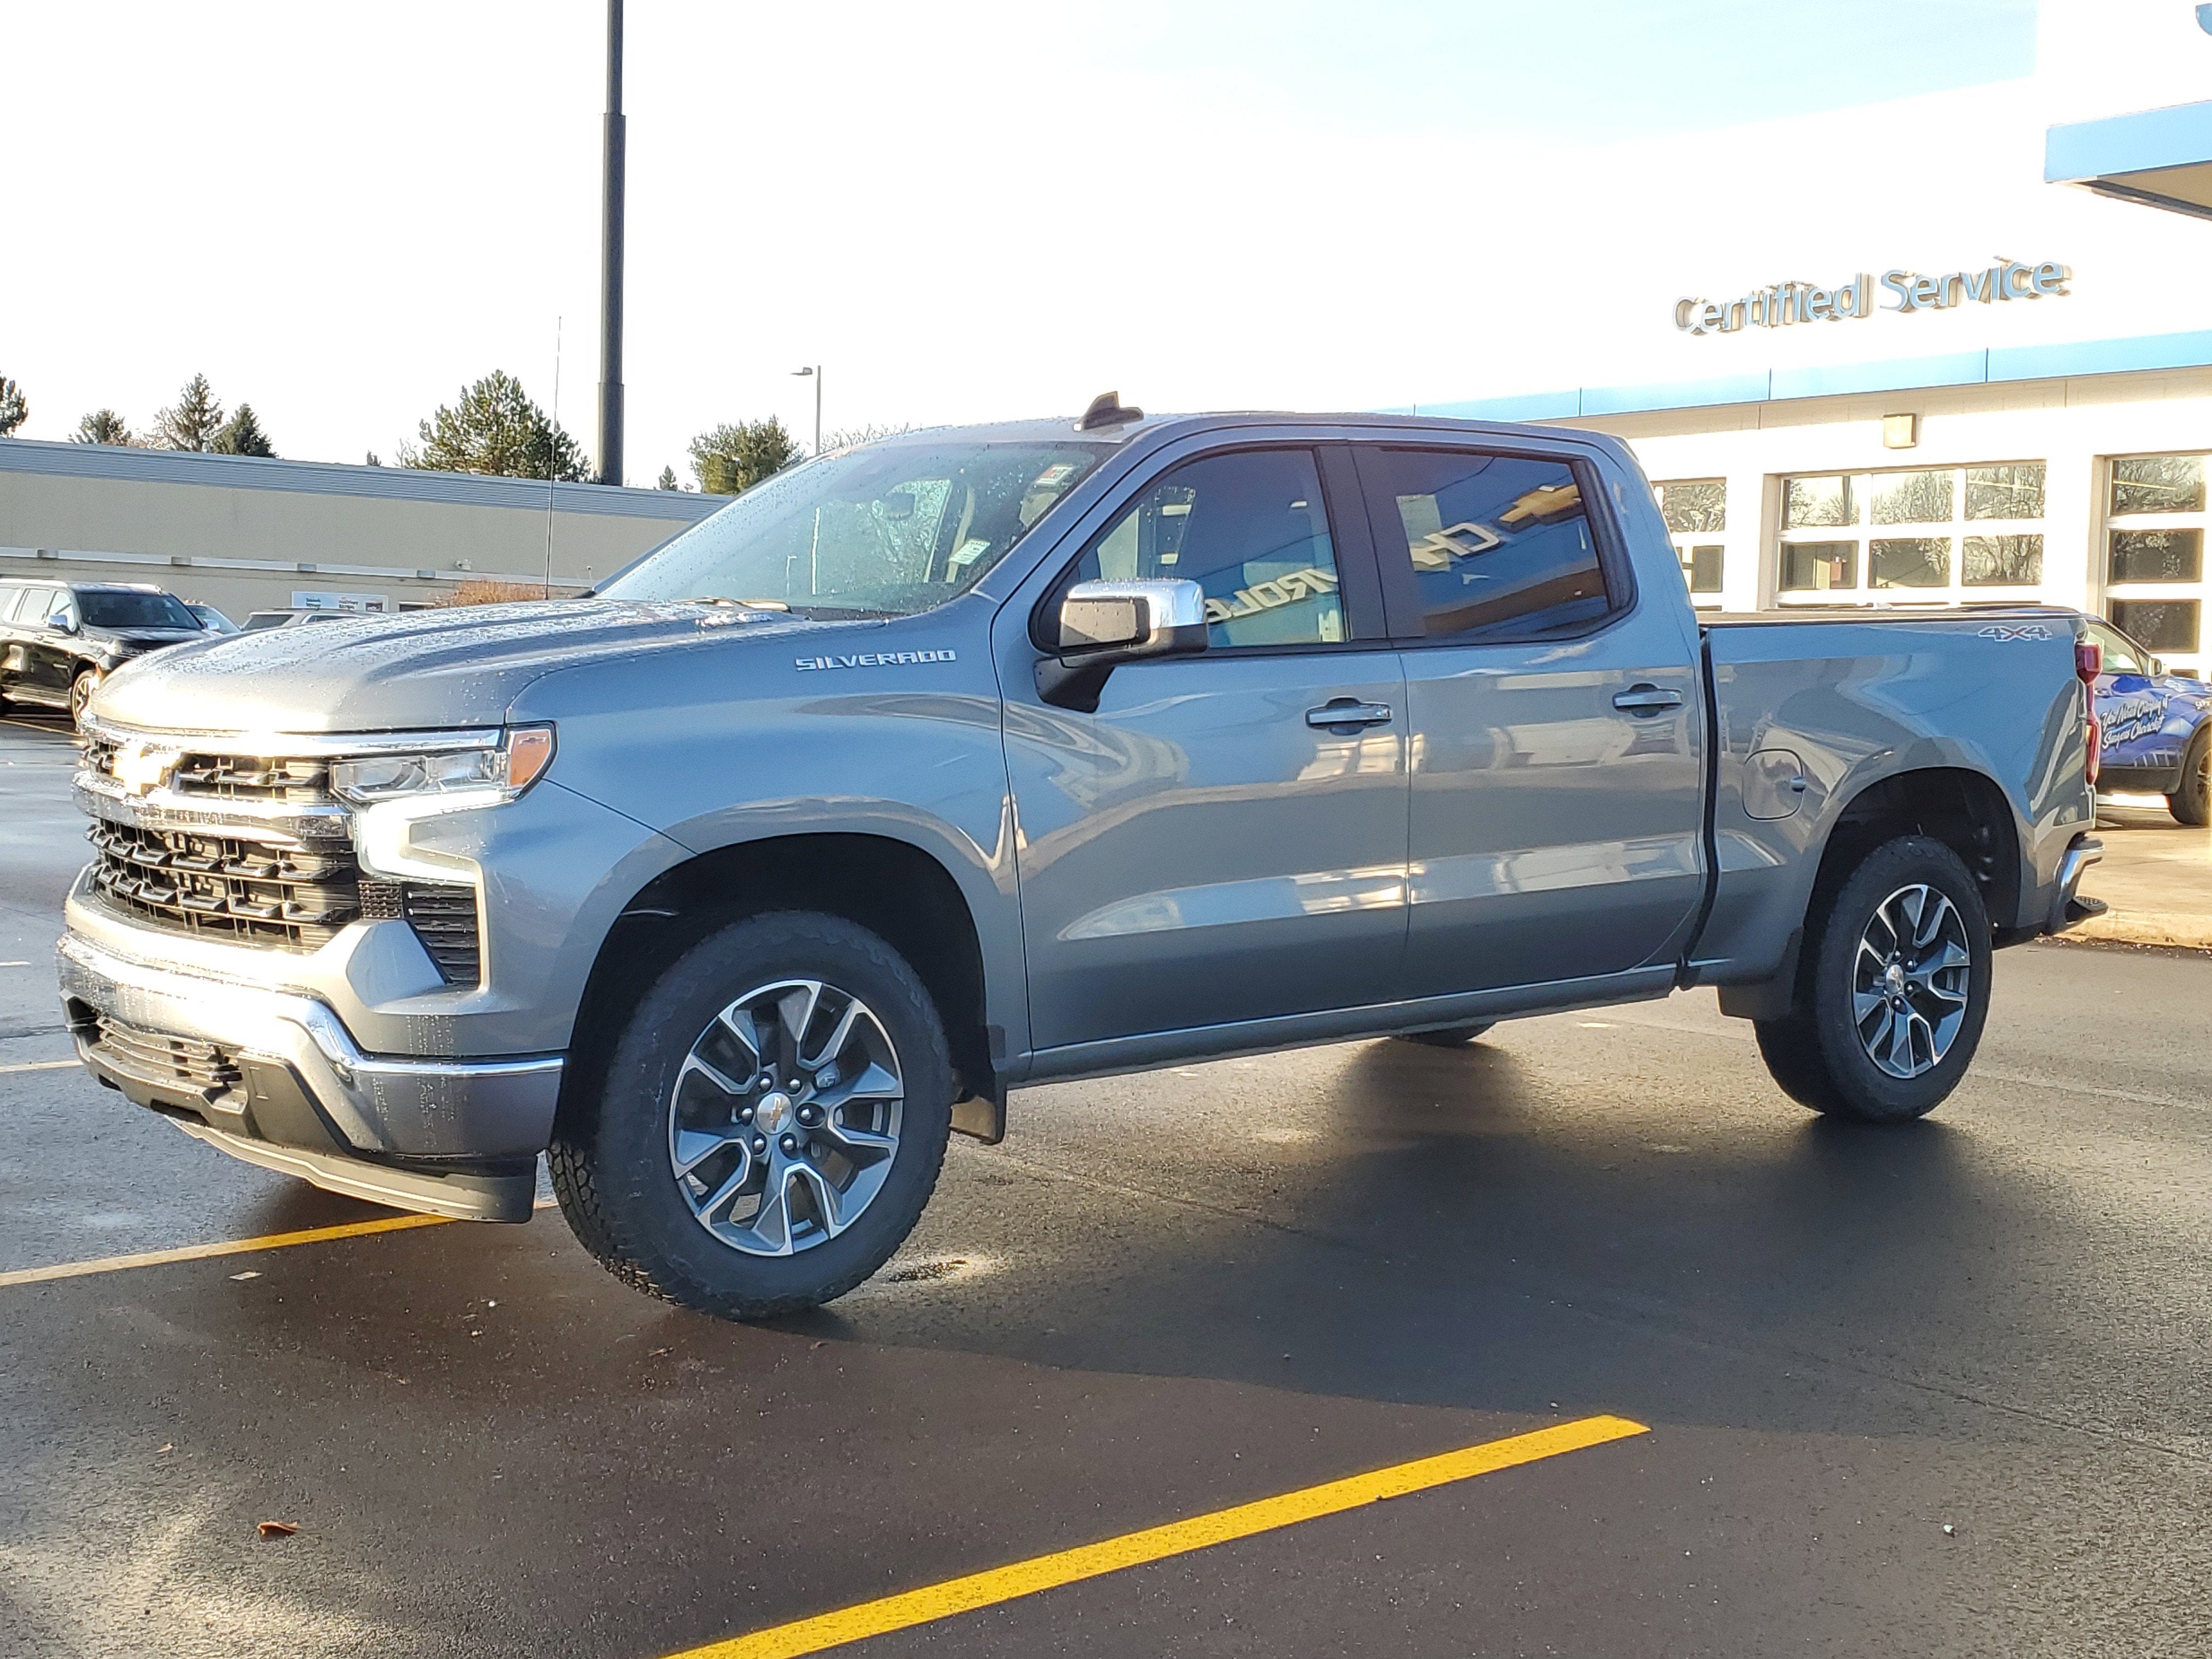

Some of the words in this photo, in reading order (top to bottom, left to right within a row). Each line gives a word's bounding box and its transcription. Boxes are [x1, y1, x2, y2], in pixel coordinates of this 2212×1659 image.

[1673, 272, 1875, 336] Certified
[1880, 255, 2073, 312] Service
[795, 650, 957, 671] SILVERADO
